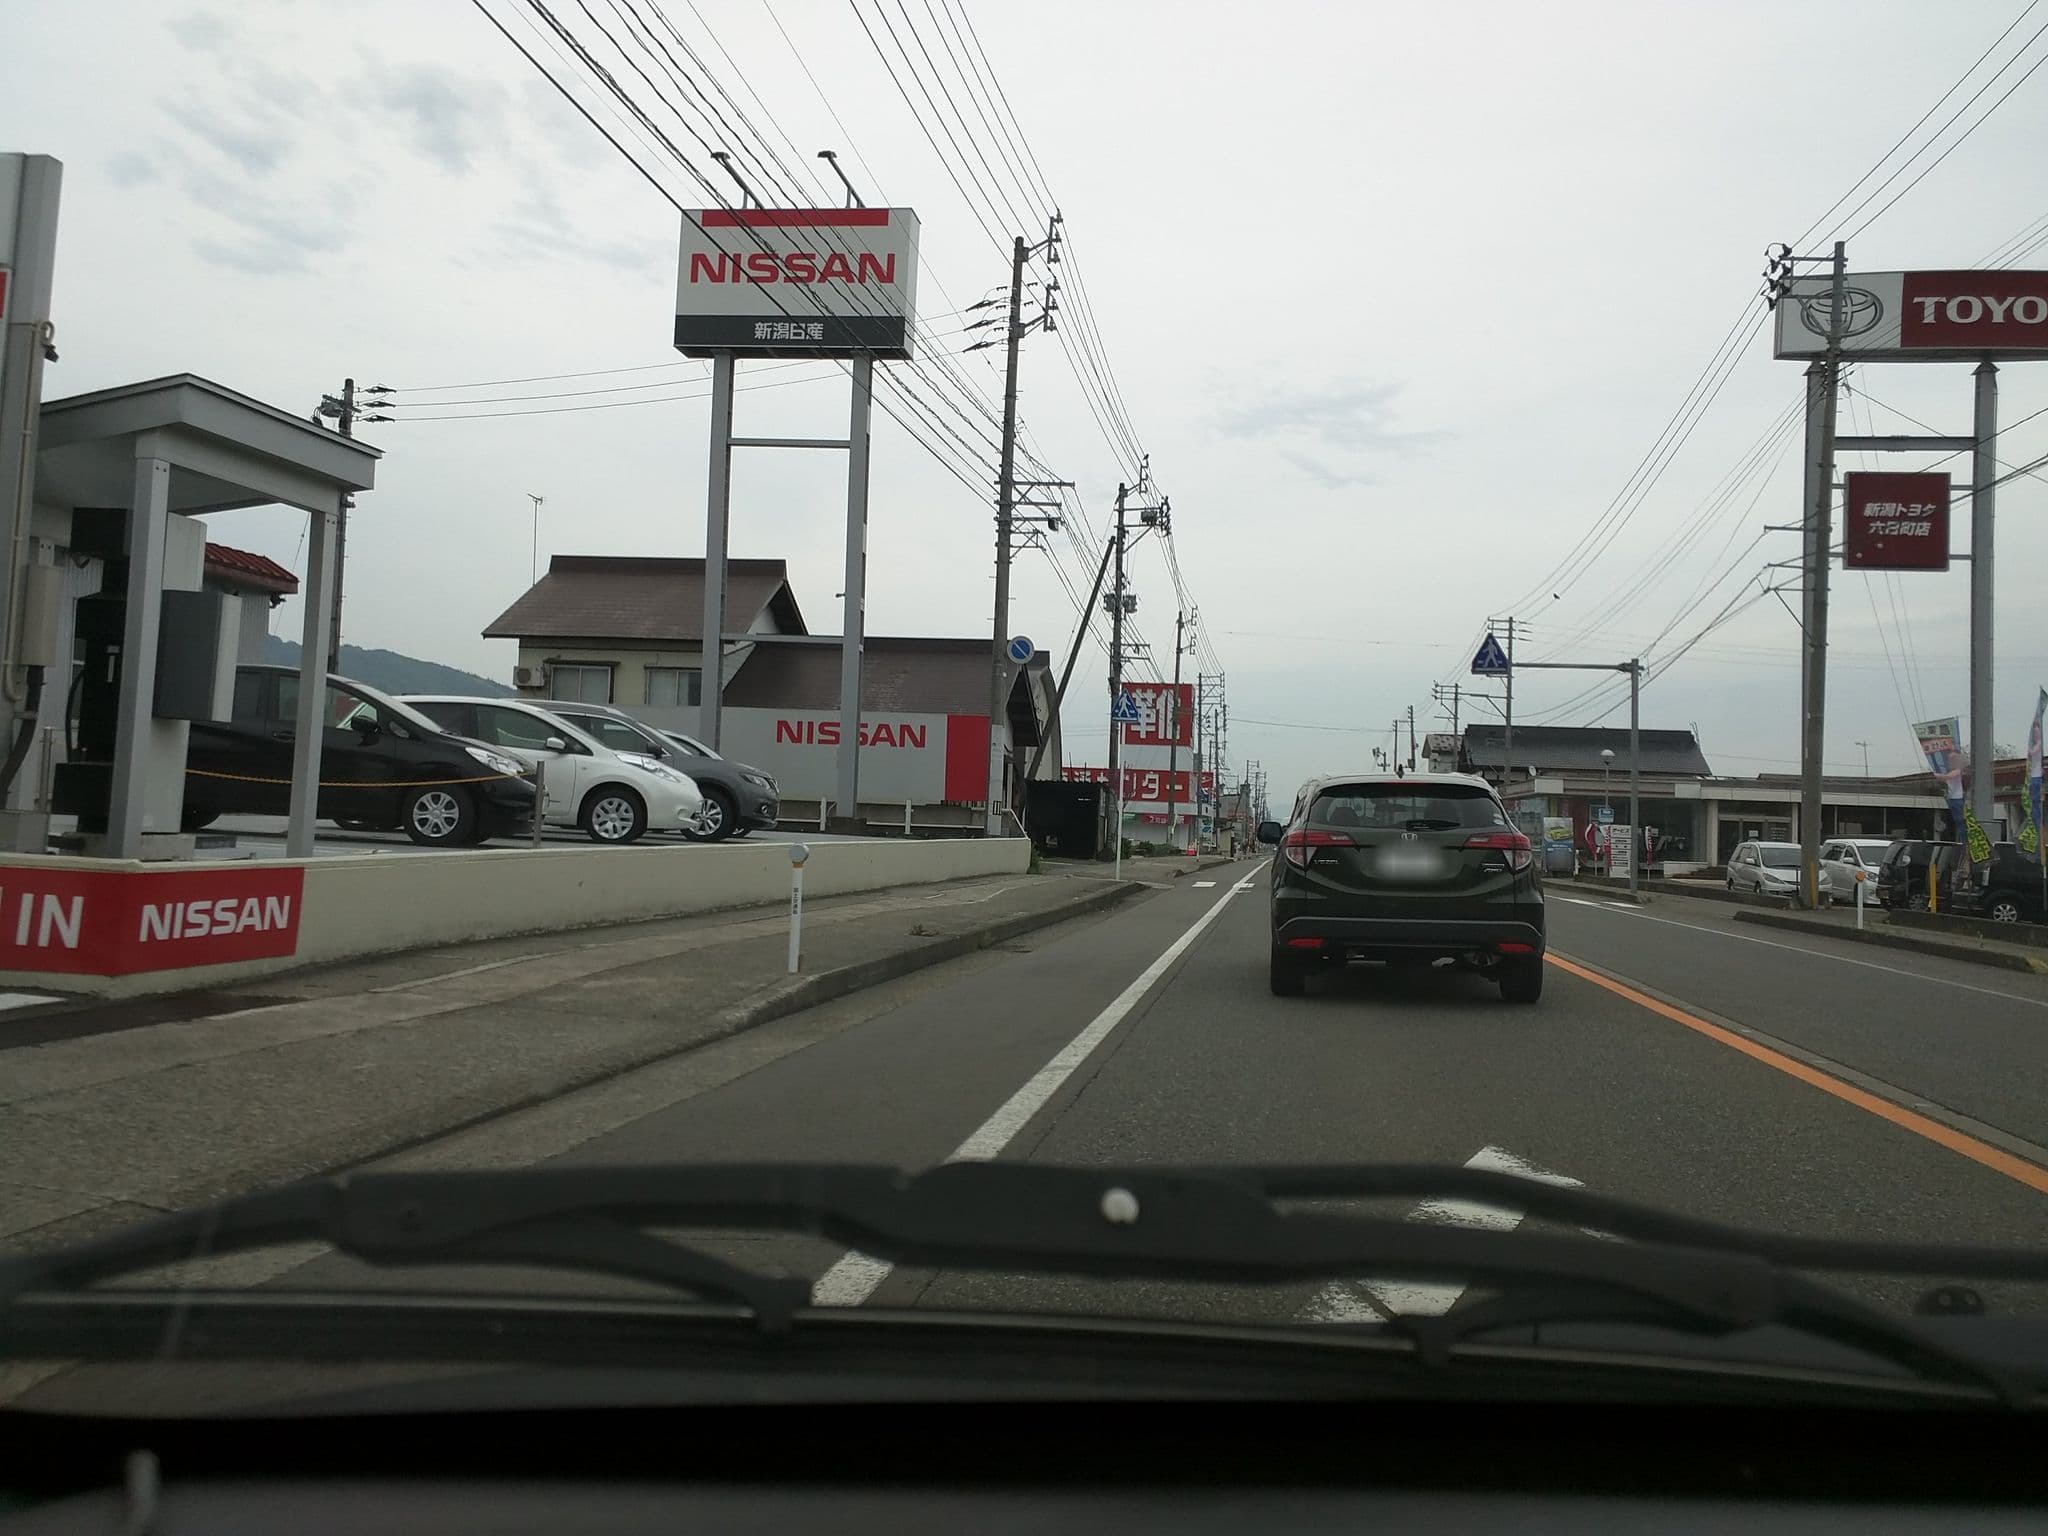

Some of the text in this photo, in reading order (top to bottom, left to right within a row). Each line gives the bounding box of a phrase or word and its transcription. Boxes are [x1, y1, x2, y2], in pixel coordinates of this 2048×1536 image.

[690, 253, 896, 284] NISSAN
[1912, 295, 2048, 324] TOYO
[754, 321, 824, 341] 新潟日産
[1863, 502, 1937, 517] 新潟トヨタ
[139, 895, 290, 942] NISSAN
